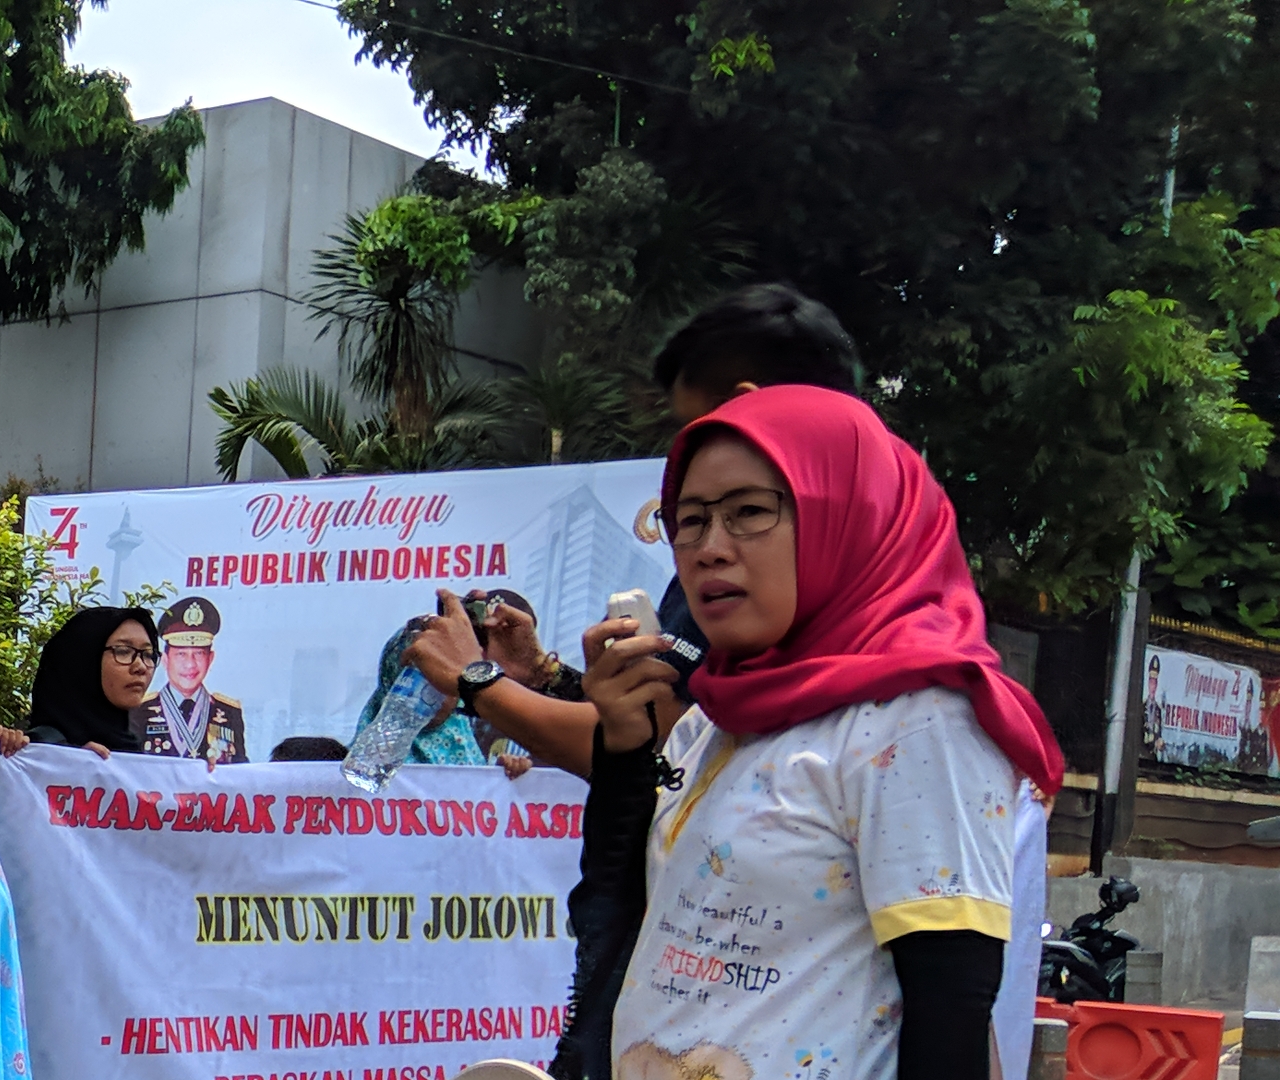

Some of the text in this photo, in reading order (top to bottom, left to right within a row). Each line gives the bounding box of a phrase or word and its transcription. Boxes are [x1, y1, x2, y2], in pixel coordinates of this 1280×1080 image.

[246, 485, 450, 546] Dirgahayu
[186, 543, 508, 588] REPUBLIK INDONESIA
[46, 785, 276, 834] EMAK-EMAK
[283, 796, 498, 838] PENDUKUNG
[195, 895, 414, 943] MENUNTUT
[422, 894, 556, 942] JOKOWI
[720, 934, 761, 955] when
[121, 1015, 258, 1054] HENTIKAN
[268, 1012, 369, 1049] TINDAK
[379, 1007, 522, 1045] KEKERASAN
